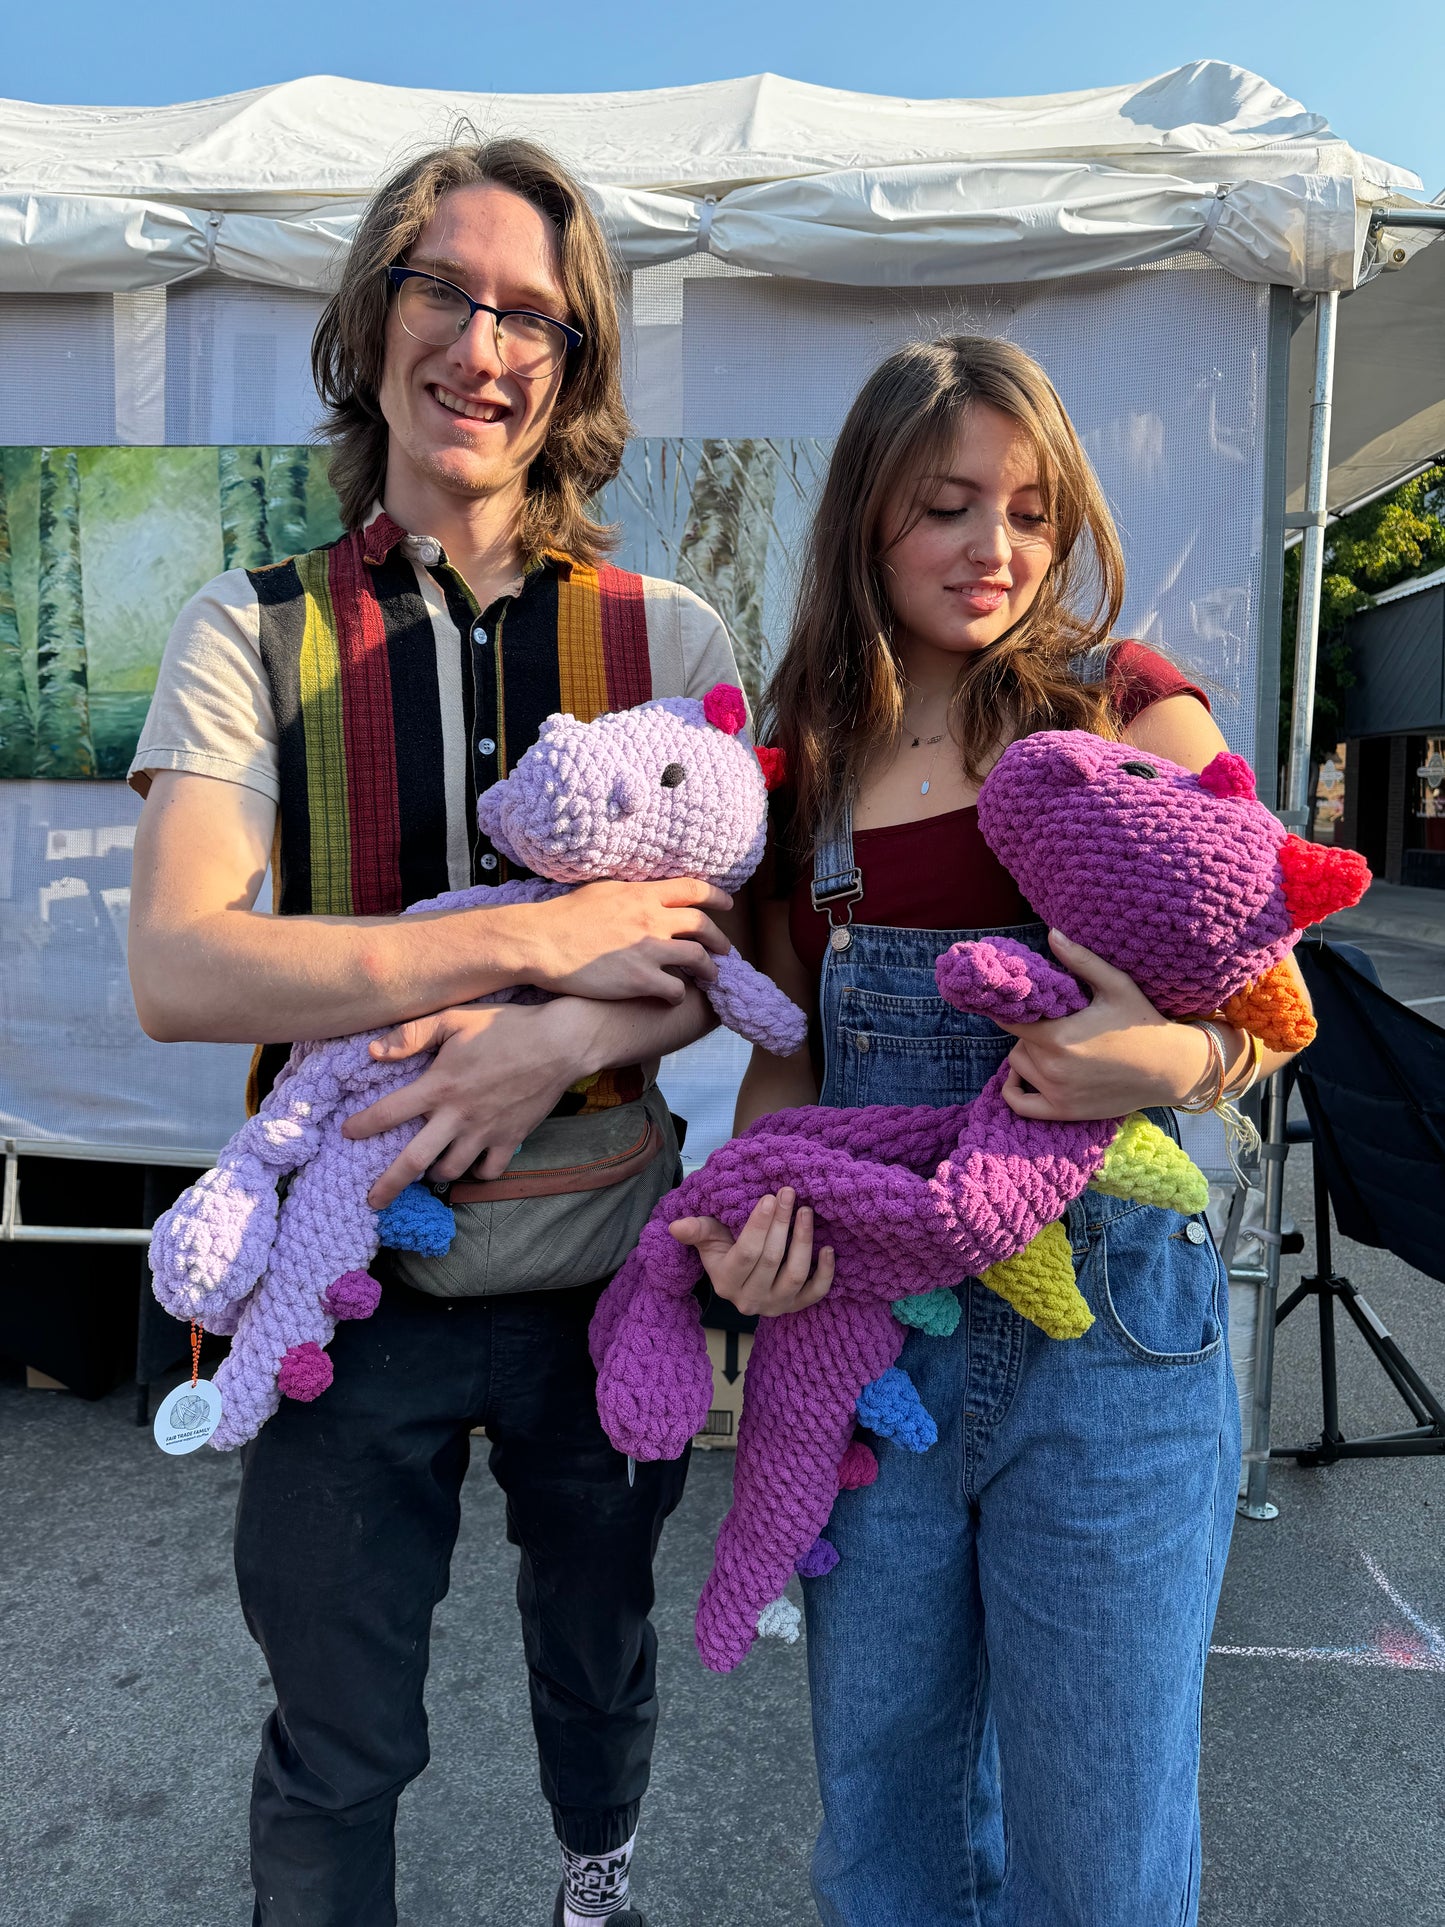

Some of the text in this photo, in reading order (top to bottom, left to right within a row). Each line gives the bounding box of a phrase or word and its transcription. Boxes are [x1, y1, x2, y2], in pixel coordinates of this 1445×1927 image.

[177, 1431, 193, 1439] TRADE
[193, 1427, 210, 1435] FAMILY
[567, 1877, 621, 1903] UCK
